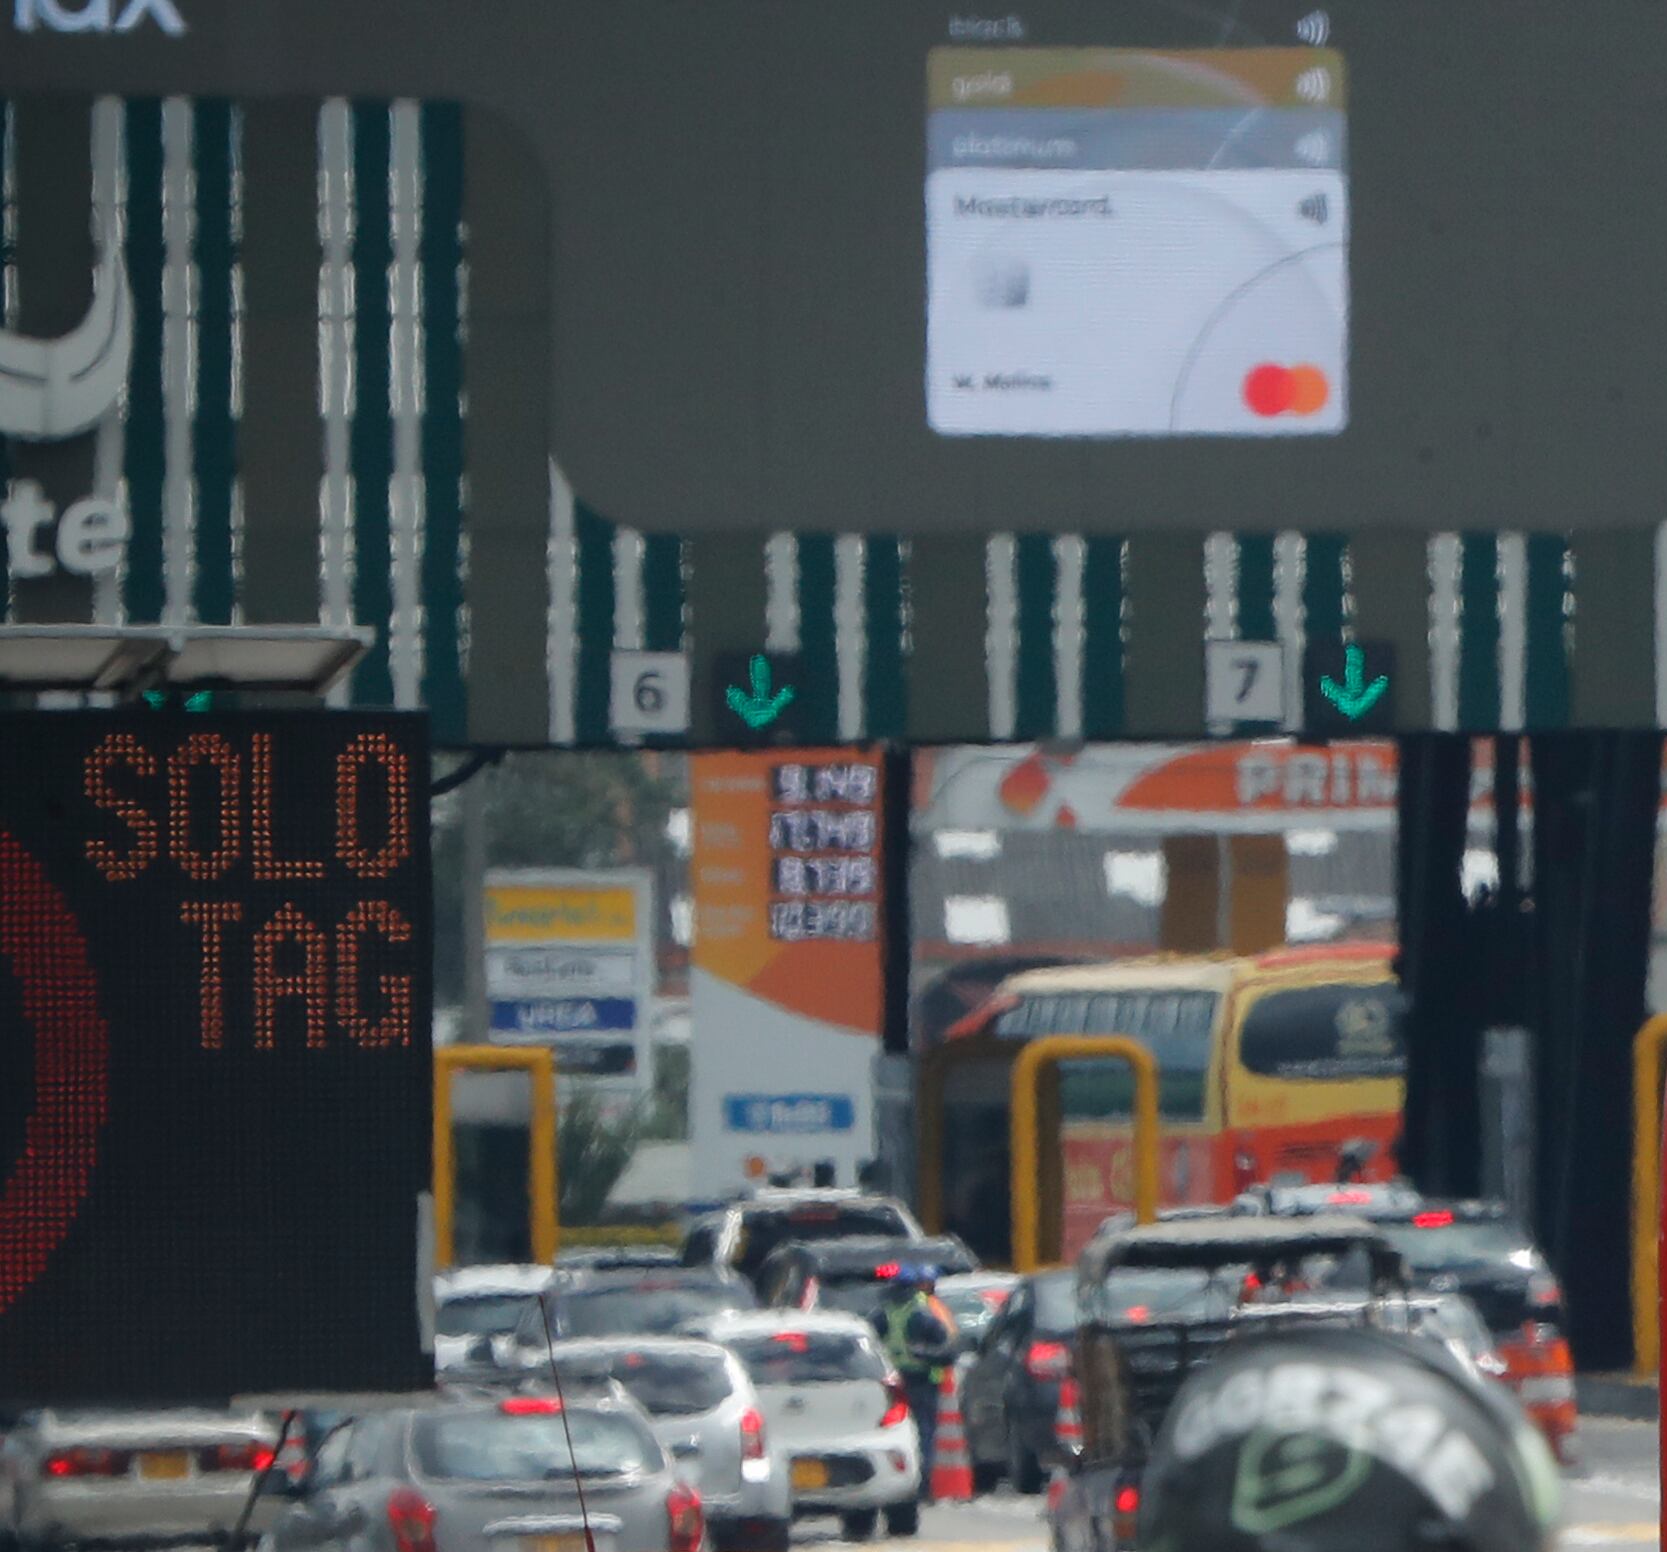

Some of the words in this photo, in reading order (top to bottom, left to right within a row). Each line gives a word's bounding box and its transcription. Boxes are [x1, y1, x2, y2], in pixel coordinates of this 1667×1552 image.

[952, 70, 1014, 100] gold
[634, 675, 667, 713] 6
[1232, 659, 1260, 702] 7
[83, 732, 410, 883] SOLO
[180, 900, 411, 1050] TAG
